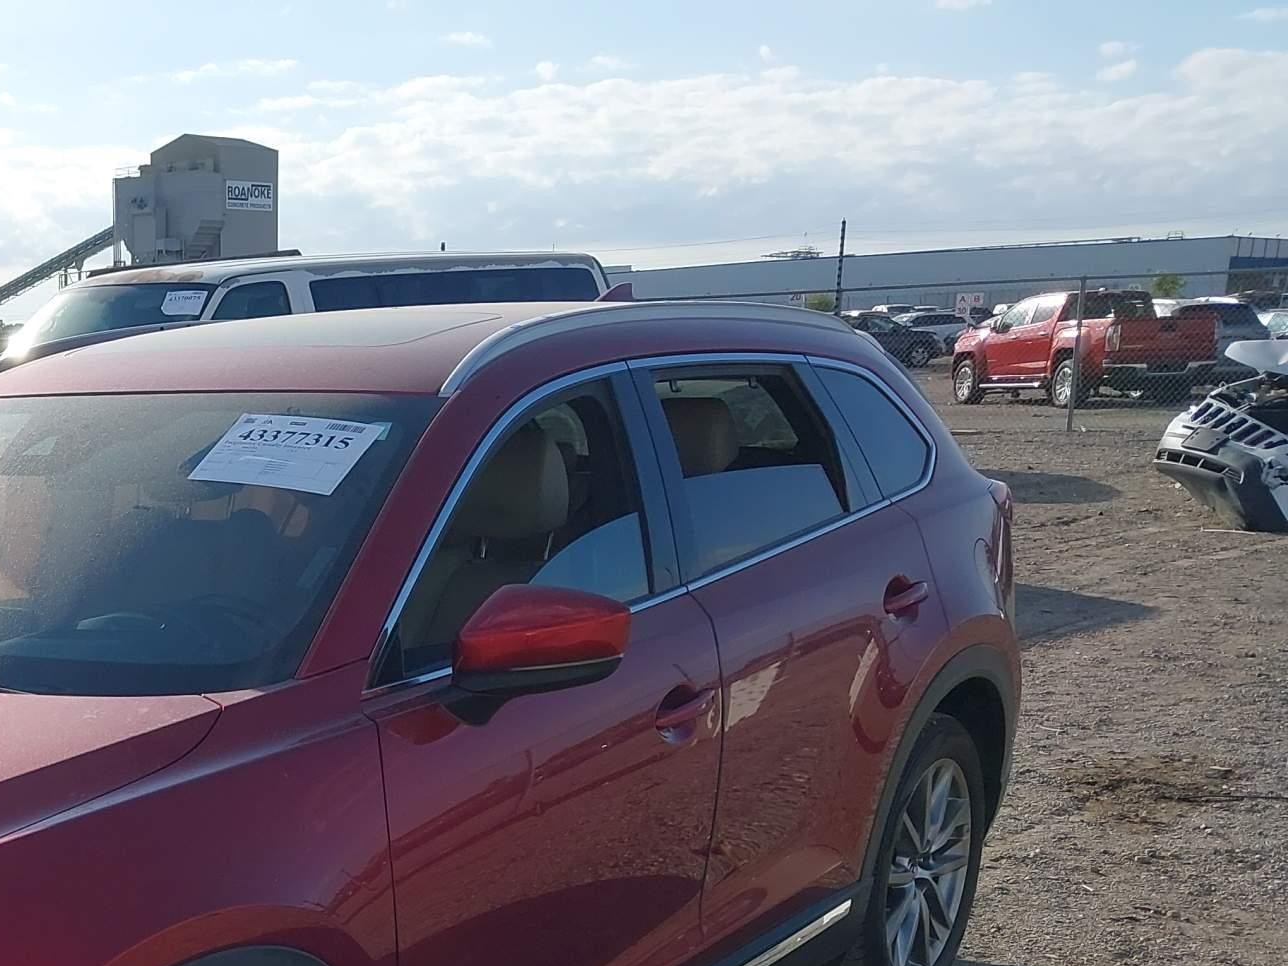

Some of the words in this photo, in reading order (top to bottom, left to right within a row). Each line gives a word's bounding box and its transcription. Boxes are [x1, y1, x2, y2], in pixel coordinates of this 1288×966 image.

[227, 185, 272, 199] ROANOKE
[959, 295, 967, 303] A
[973, 295, 981, 303] B
[237, 428, 355, 450] 43377315
